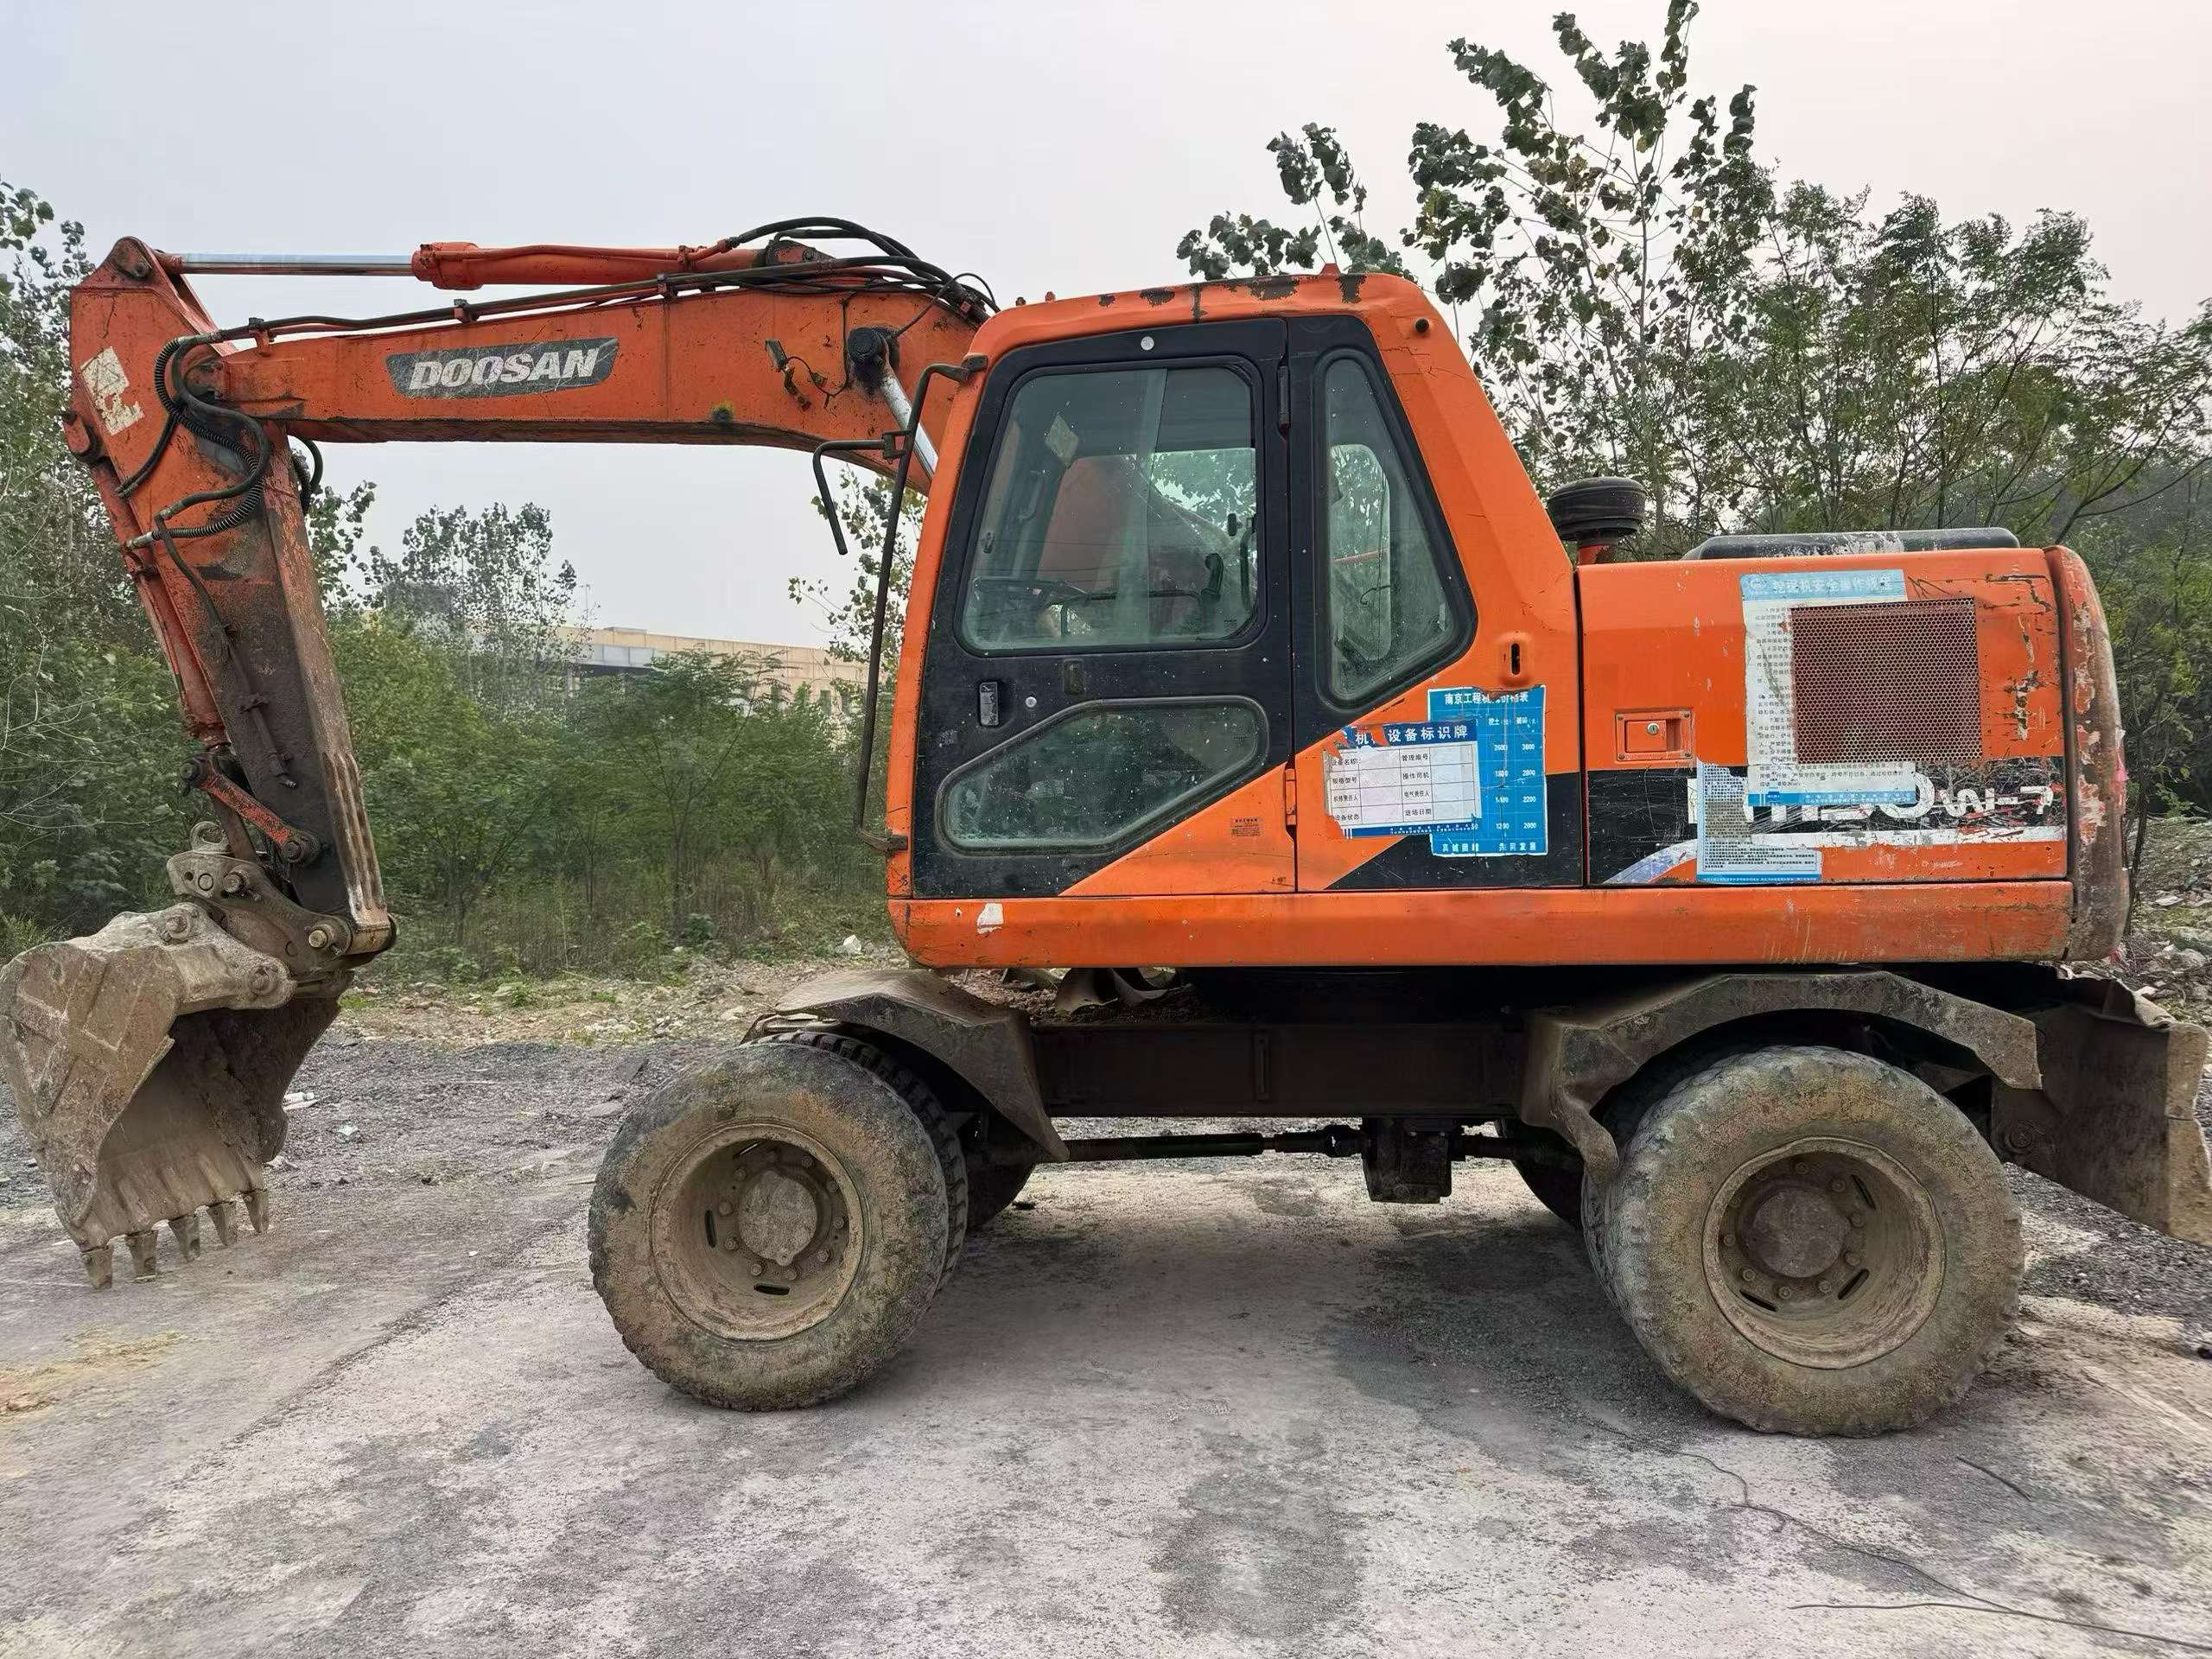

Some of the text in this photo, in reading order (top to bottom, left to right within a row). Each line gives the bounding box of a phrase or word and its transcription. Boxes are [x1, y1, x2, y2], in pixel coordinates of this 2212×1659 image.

[409, 348, 600, 390] DOOSAN
[1445, 692, 1529, 705] 南京工程机价格表
[1355, 725, 1468, 745] 机设备标识牌
